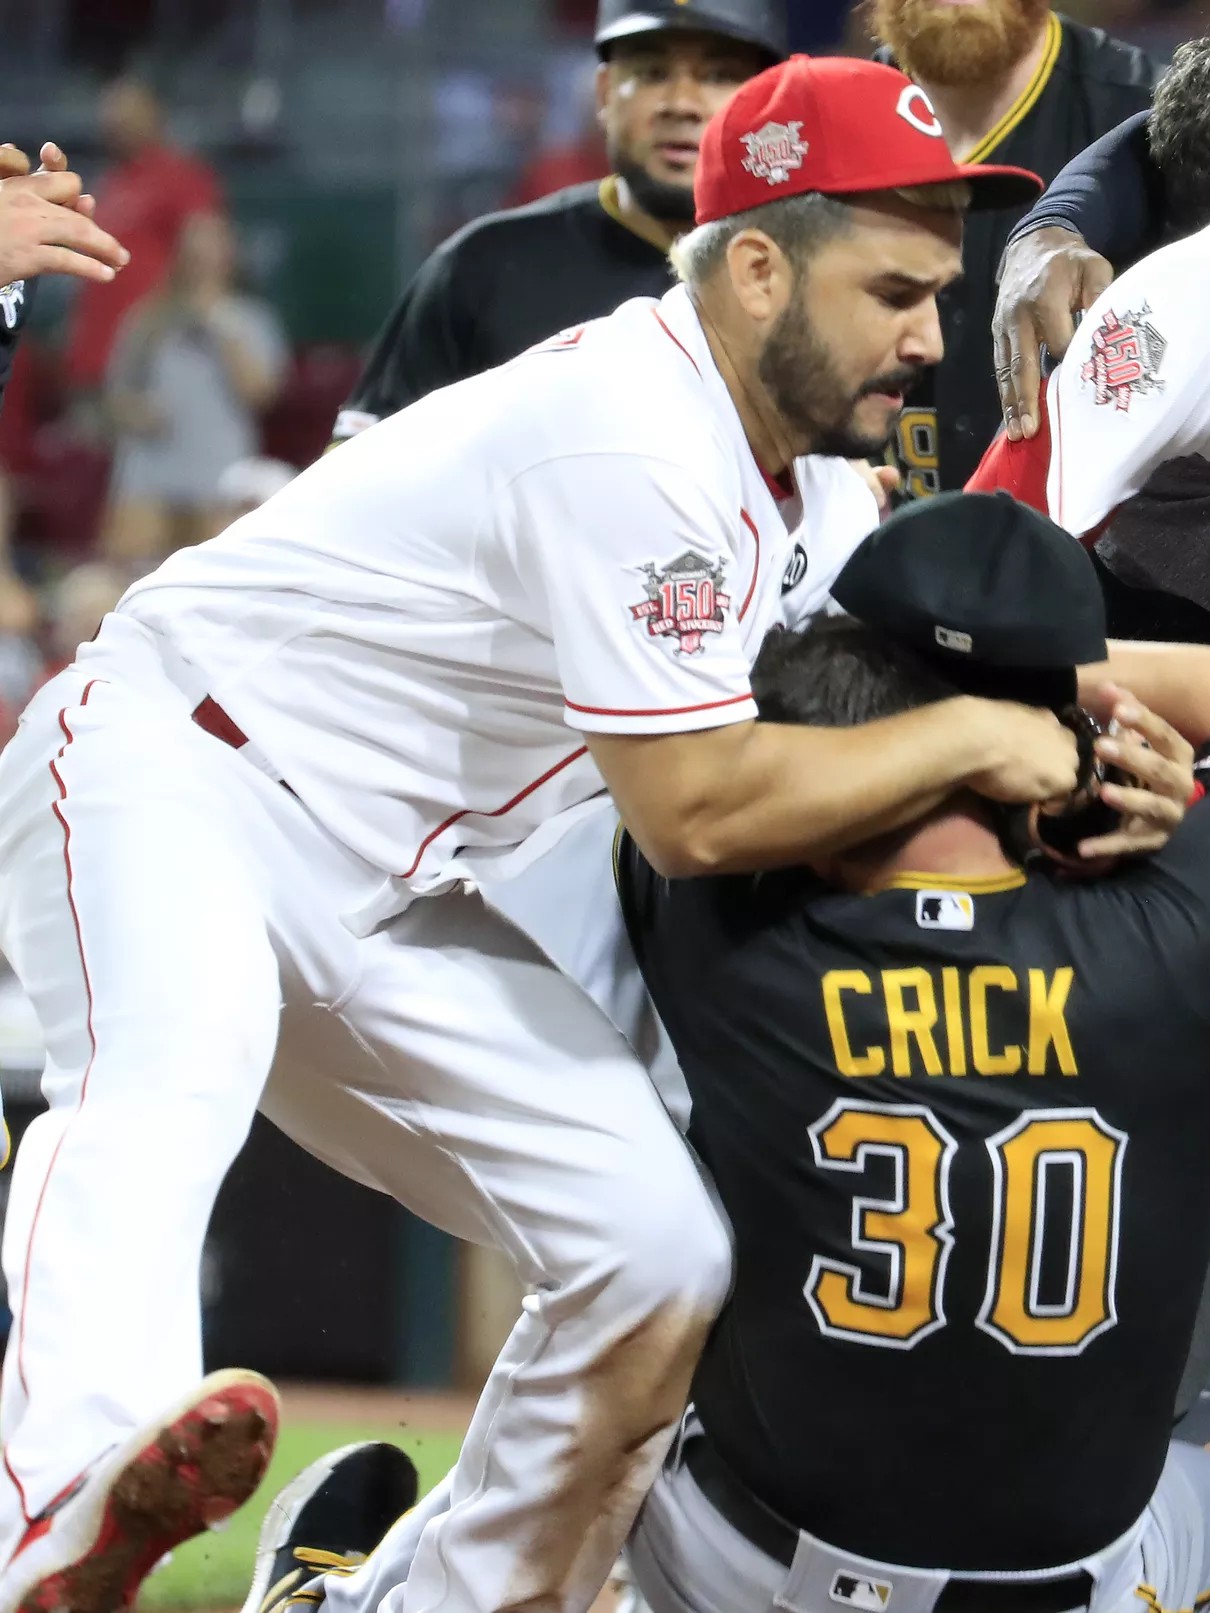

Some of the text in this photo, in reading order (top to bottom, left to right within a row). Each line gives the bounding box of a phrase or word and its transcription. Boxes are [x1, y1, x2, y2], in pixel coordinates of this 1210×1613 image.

[1102, 325, 1144, 387] 150
[660, 578, 715, 622] 150
[821, 965, 1079, 1077] CRICK
[803, 1097, 1129, 1357] 30
